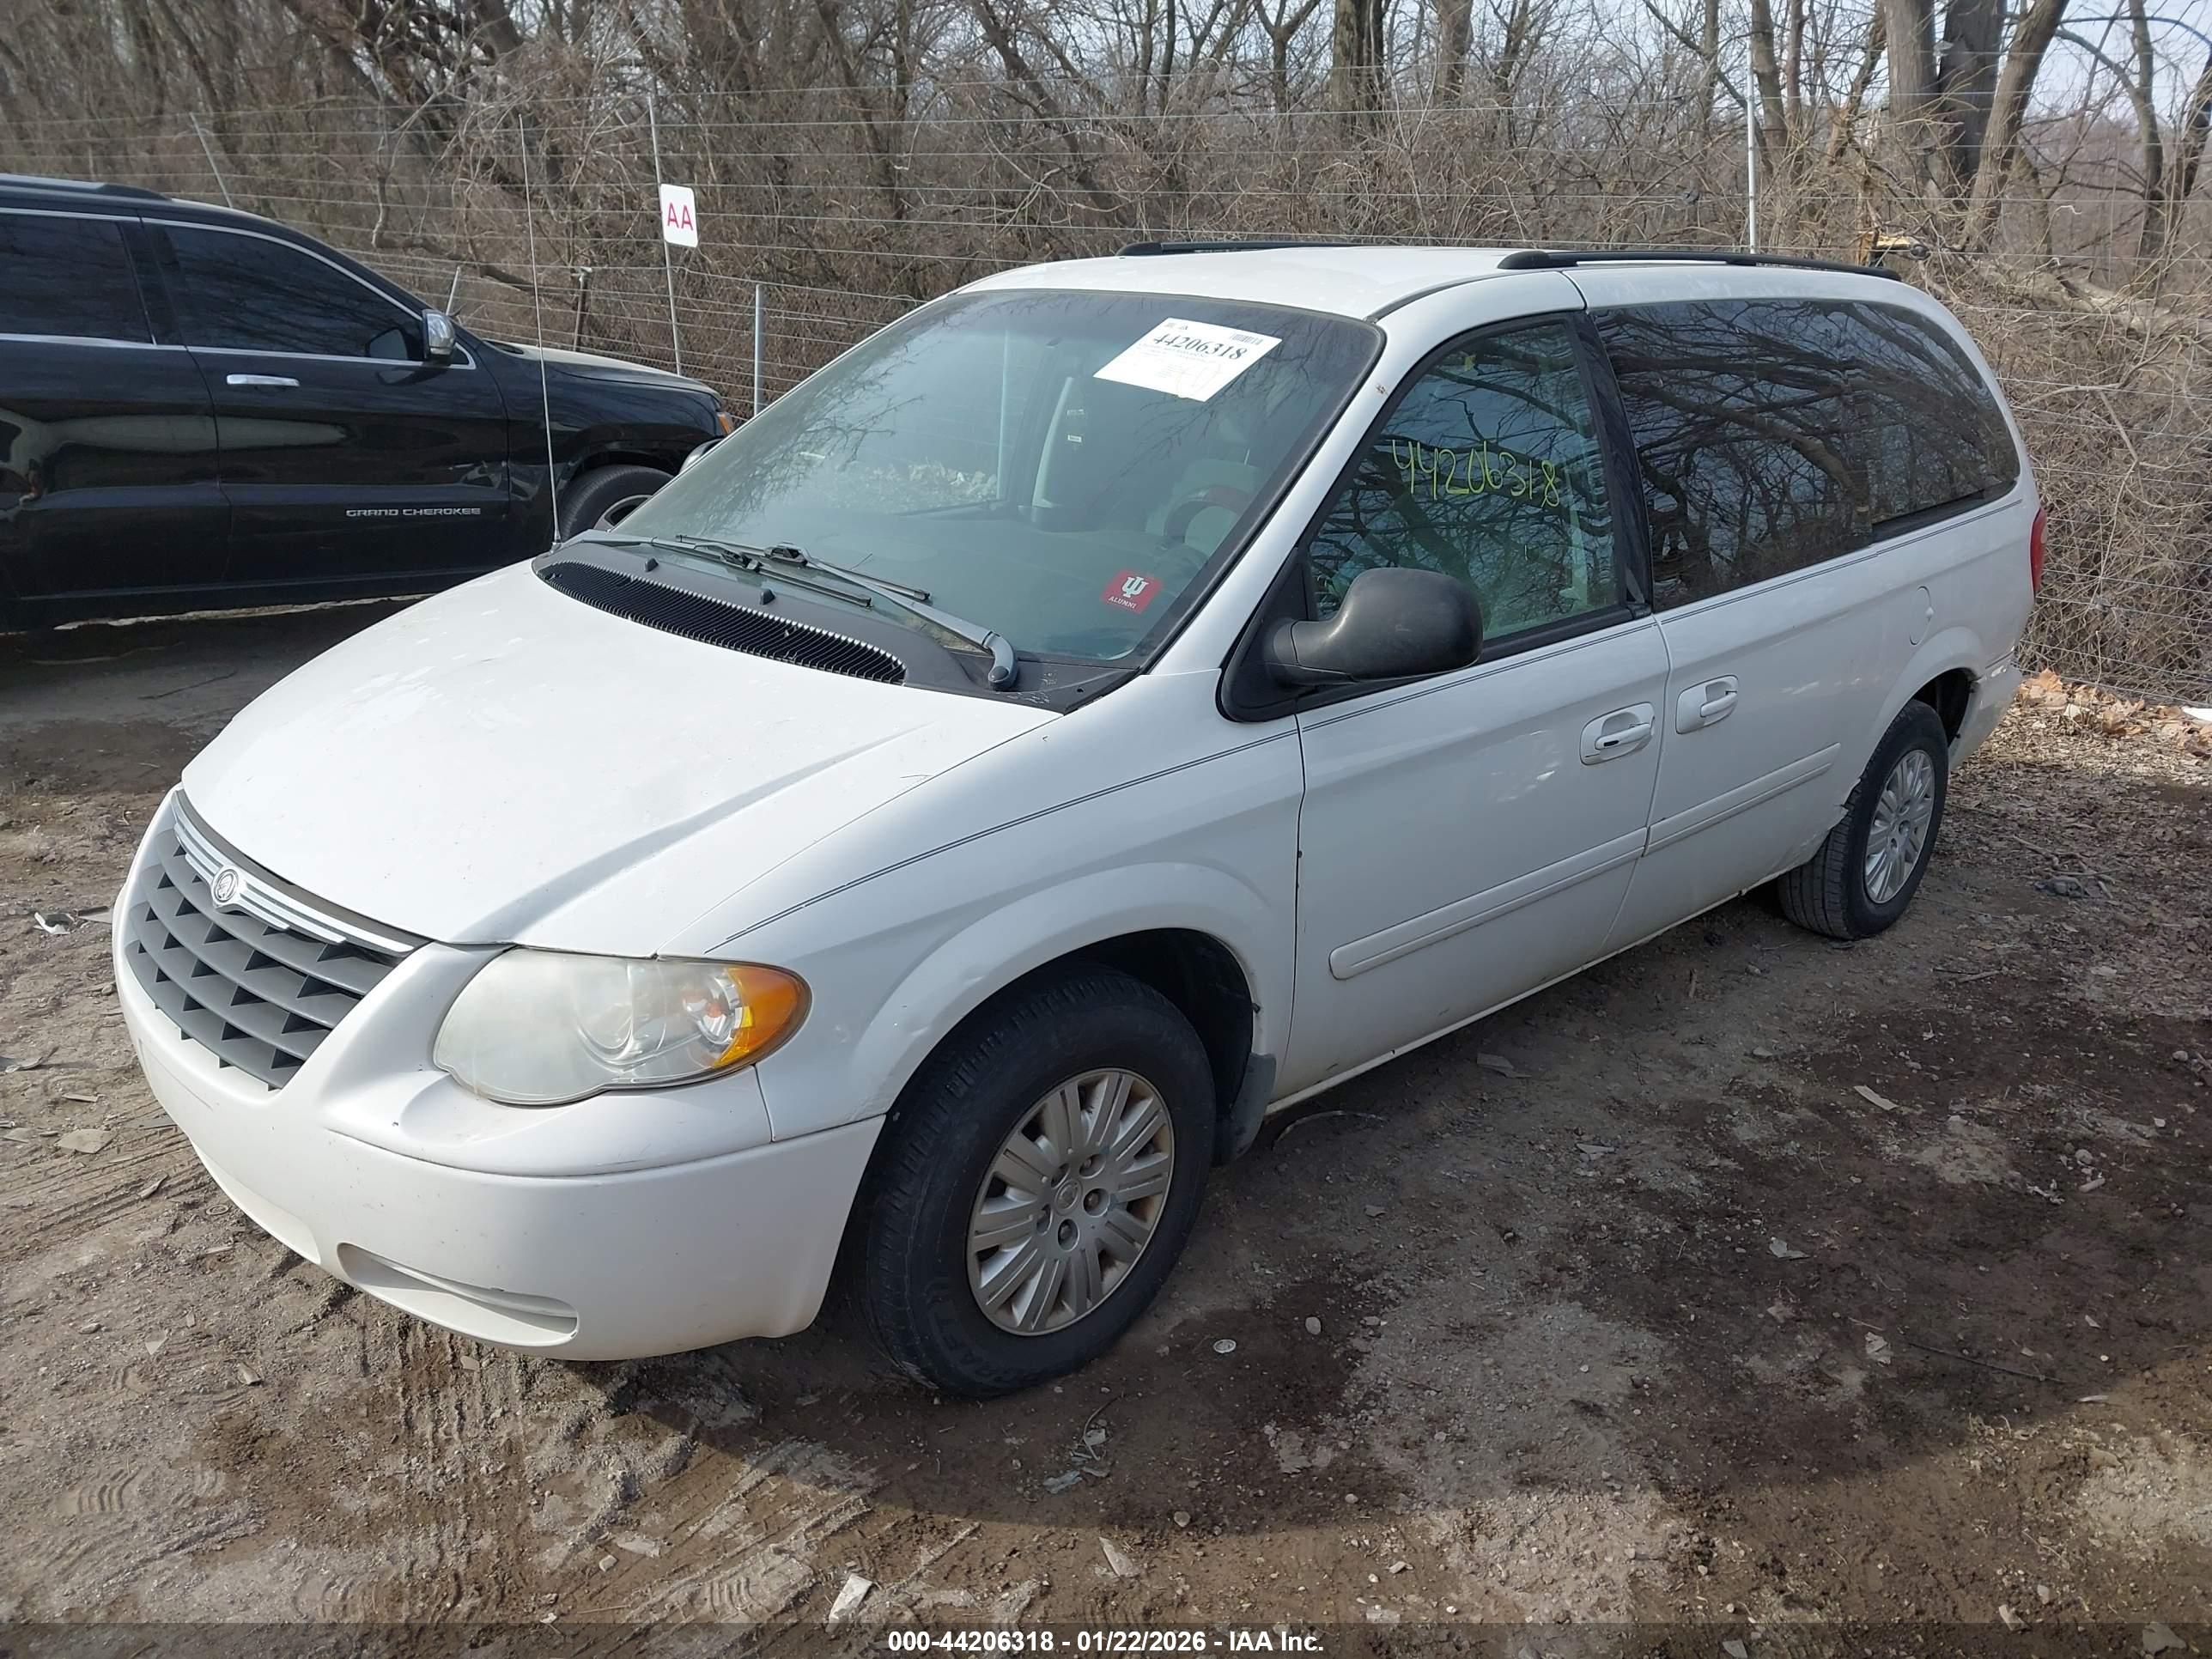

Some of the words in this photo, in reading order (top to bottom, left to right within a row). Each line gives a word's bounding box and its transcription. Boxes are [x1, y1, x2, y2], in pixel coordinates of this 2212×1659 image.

[666, 201, 694, 231] AA
[1152, 332, 1249, 361] 44206318
[1389, 439, 1560, 508] 44206318
[345, 508, 399, 517] GRAND
[402, 507, 482, 516] CHEROKEE
[1108, 595, 1138, 610] ALUMNI
